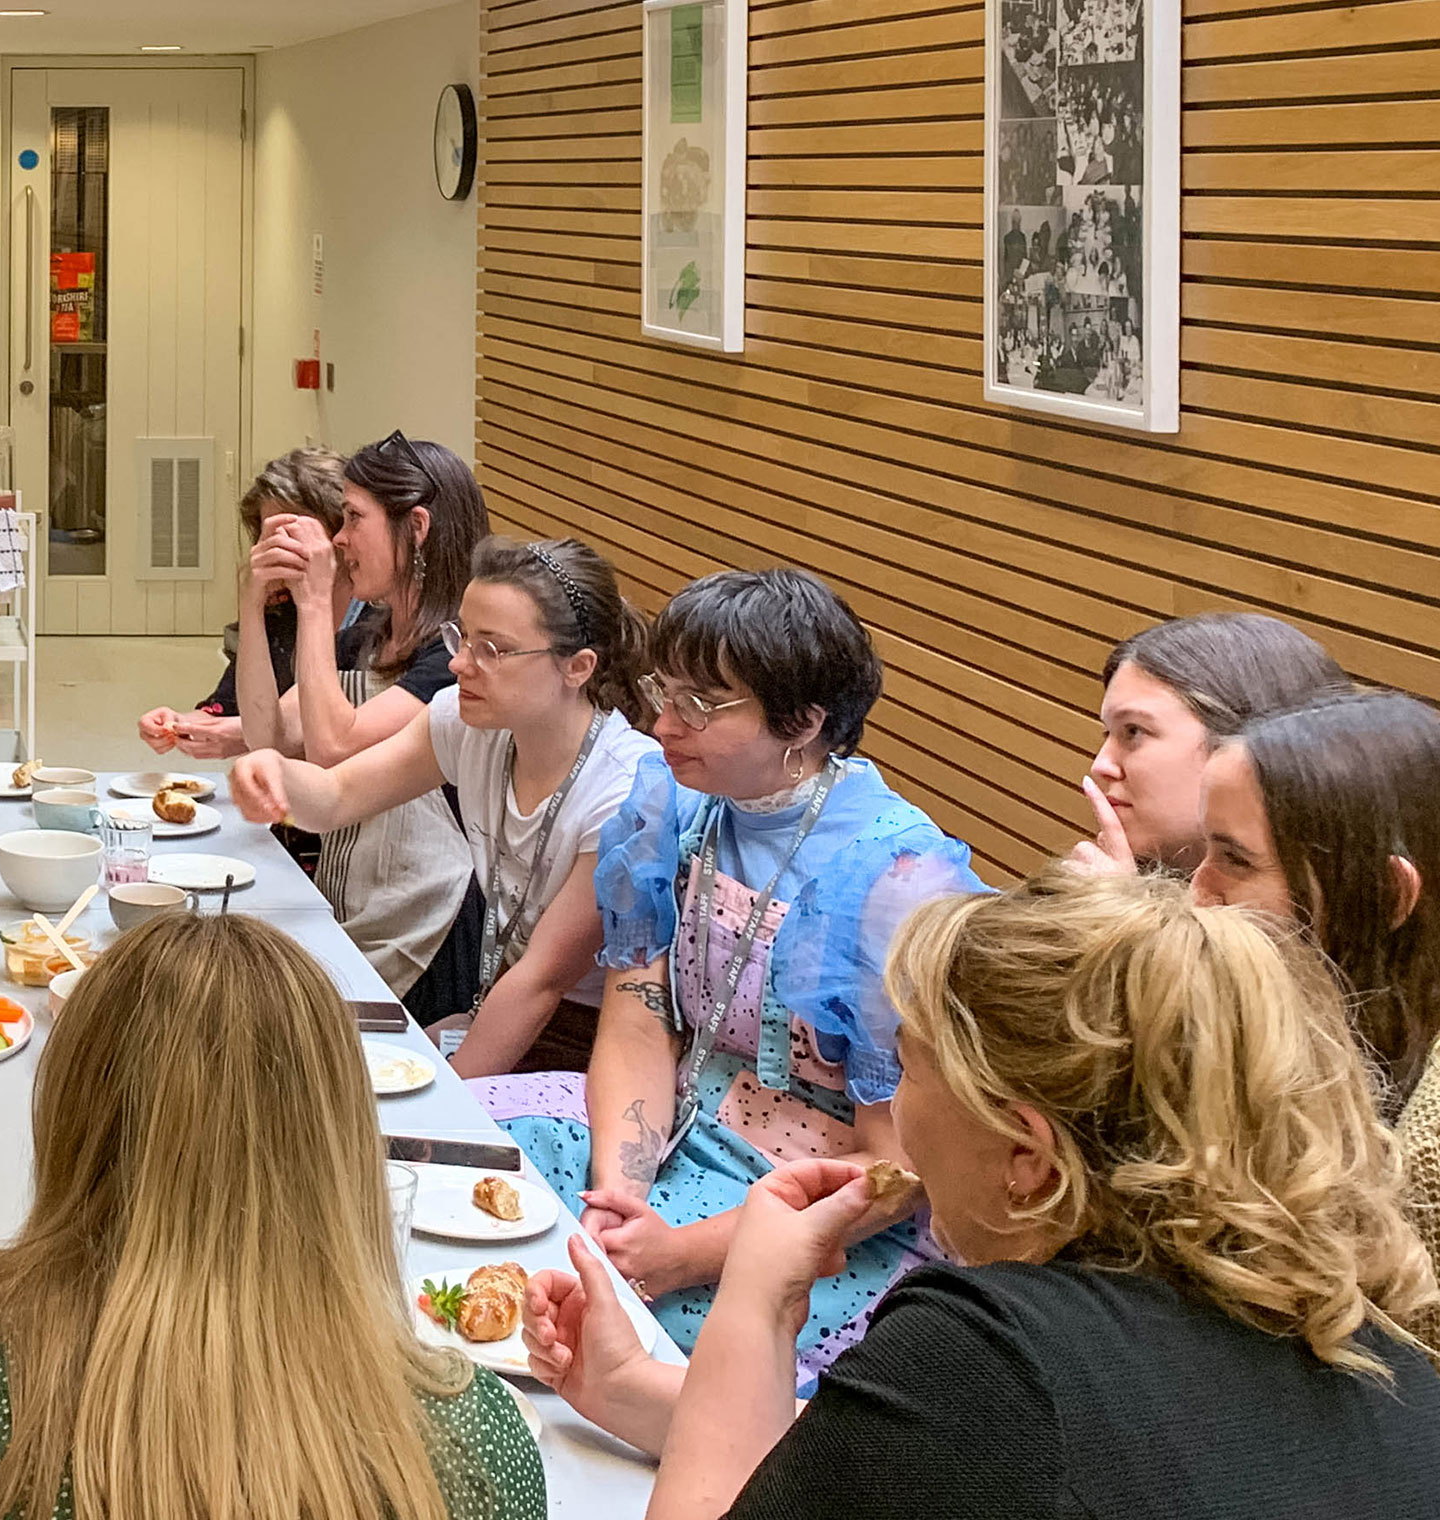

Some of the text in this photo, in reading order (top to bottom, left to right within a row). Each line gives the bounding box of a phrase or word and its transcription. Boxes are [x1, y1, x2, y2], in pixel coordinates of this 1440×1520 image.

[52, 291, 88, 304] ORKSHIRE
[589, 714, 603, 741] STAFF
[569, 753, 586, 780] STAFF
[547, 791, 563, 818] STAFF
[810, 785, 828, 816] STAFF
[703, 846, 715, 876] STAFF
[486, 907, 497, 936] STAFF
[699, 893, 710, 925] STAFF
[746, 909, 762, 942] STAFF
[483, 952, 492, 981] STAFF
[727, 955, 743, 988] STAFF
[708, 1001, 727, 1035] STAFF
[691, 1047, 707, 1081] STAFF
